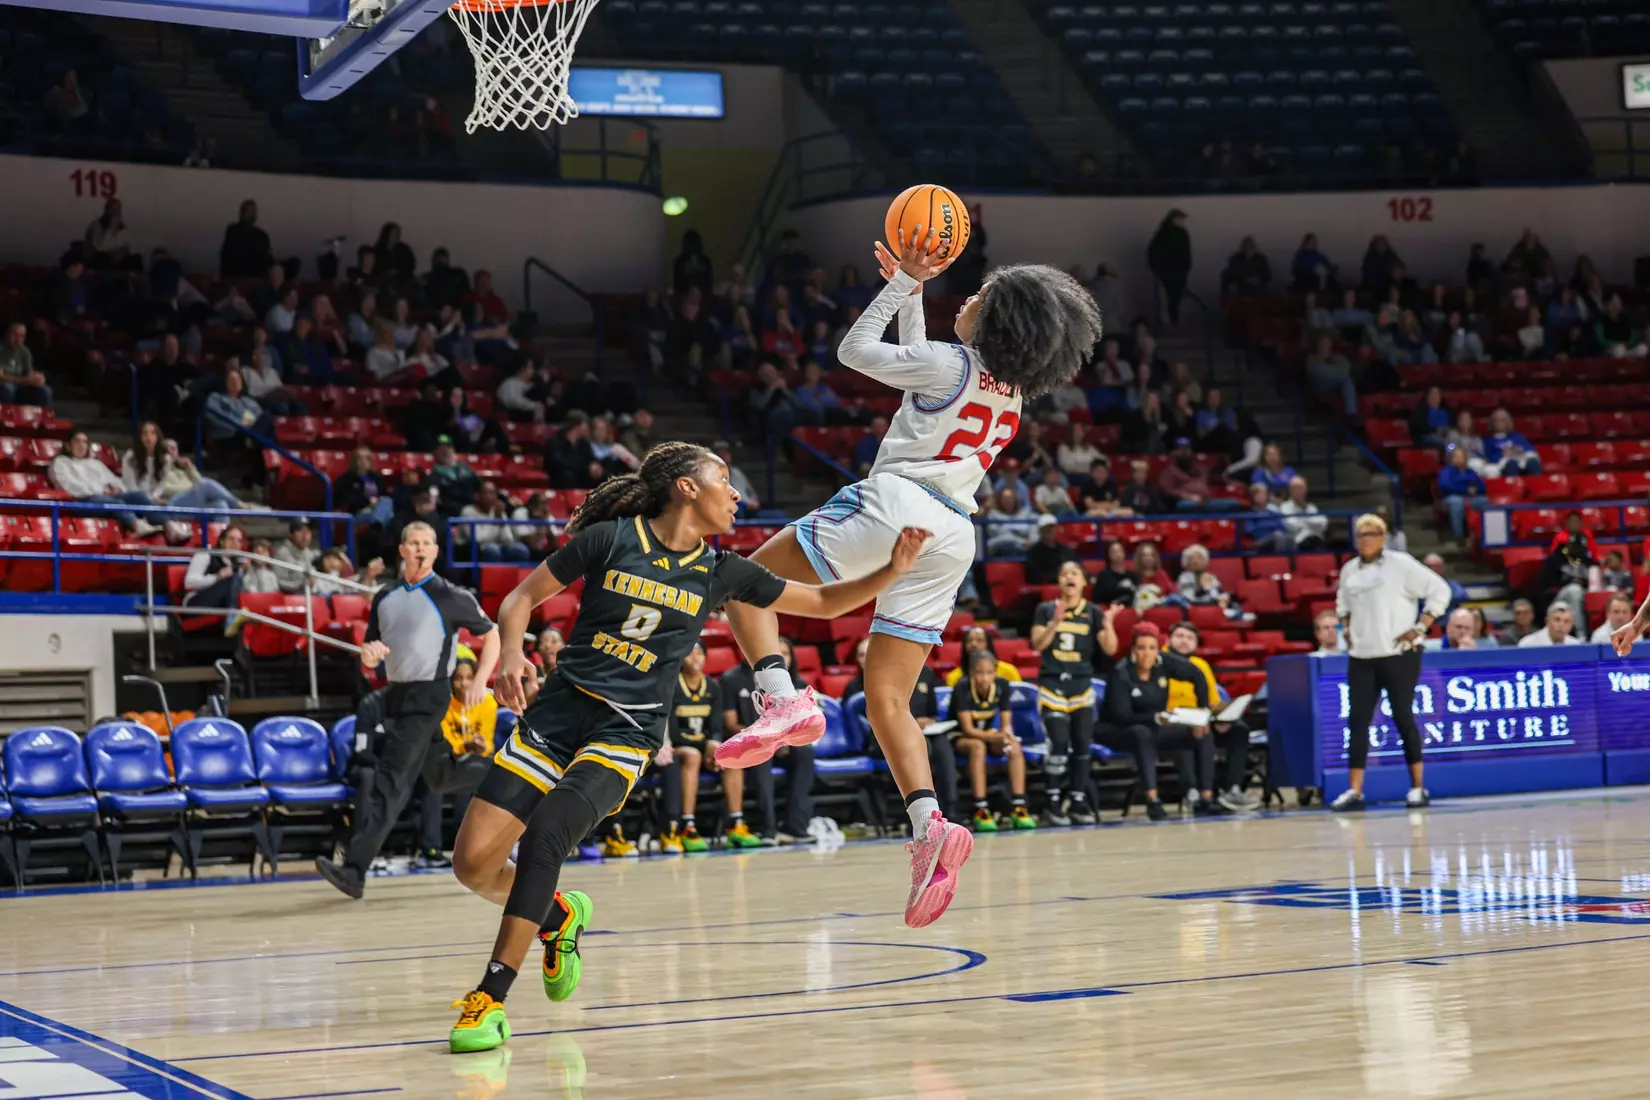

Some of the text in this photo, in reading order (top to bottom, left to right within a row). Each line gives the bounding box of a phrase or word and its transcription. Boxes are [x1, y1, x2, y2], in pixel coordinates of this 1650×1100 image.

[69, 168, 116, 199] 119
[1387, 197, 1433, 221] 102
[602, 569, 703, 617] KENNESAW
[620, 603, 663, 641] 0
[591, 631, 658, 673] STATE
[1059, 632, 1075, 651] 3
[1447, 669, 1571, 713] Smith
[1343, 714, 1570, 749] UNITURE
